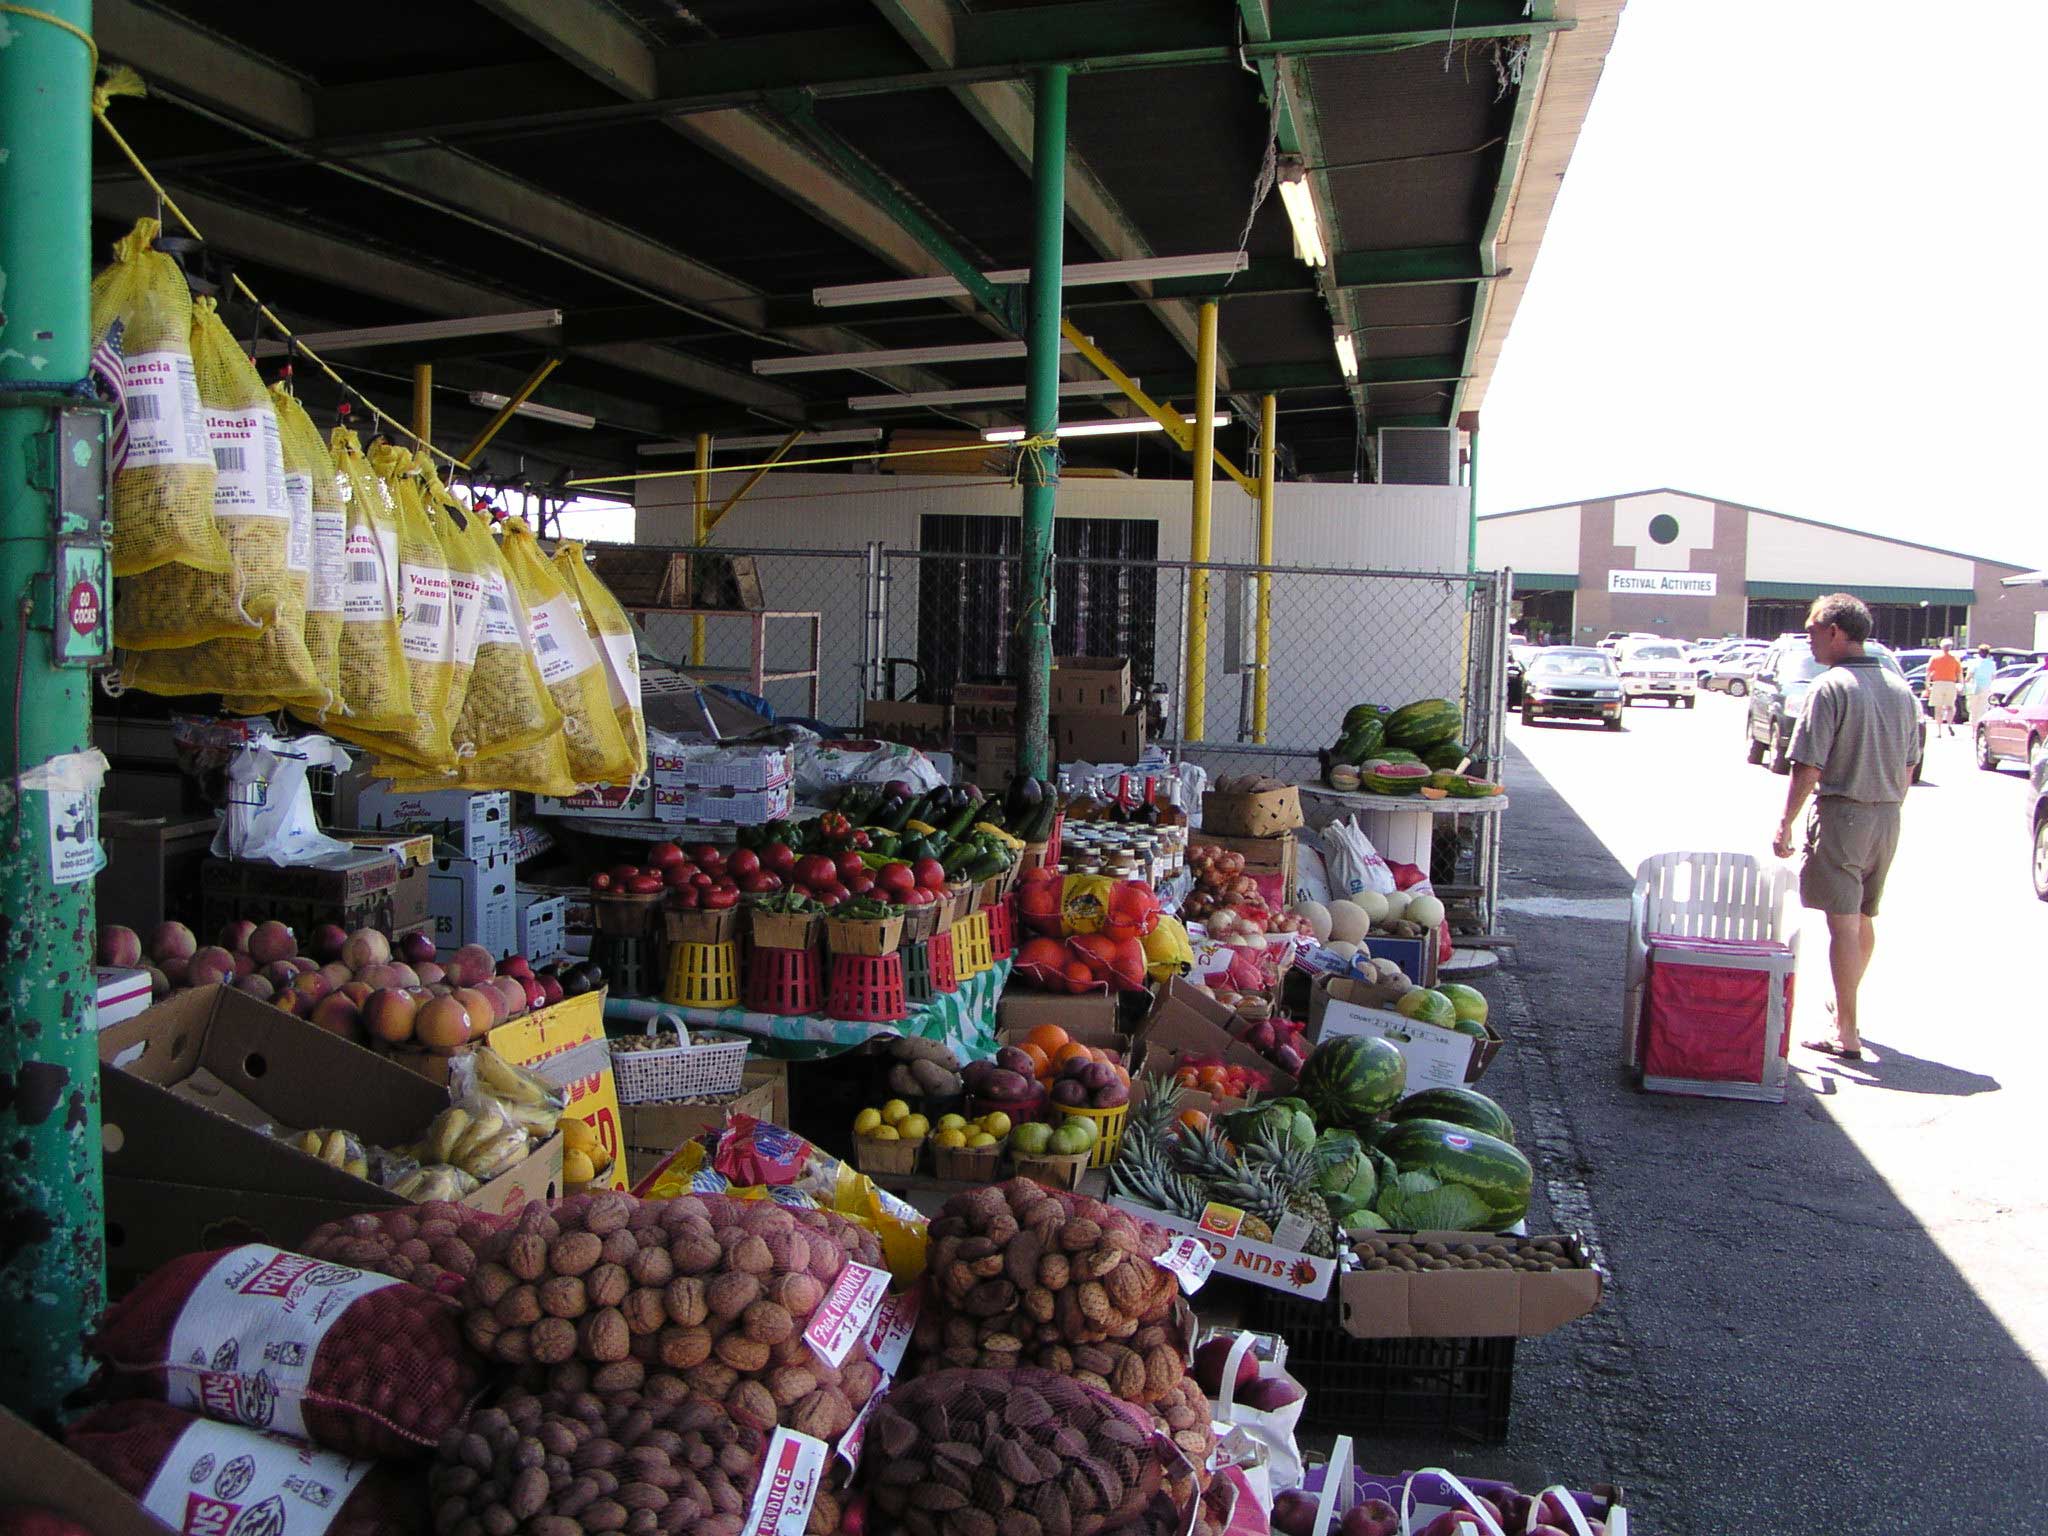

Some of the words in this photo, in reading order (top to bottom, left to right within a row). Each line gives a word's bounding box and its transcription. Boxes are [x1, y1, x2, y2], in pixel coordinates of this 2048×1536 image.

[209, 431, 251, 439] eanuts
[451, 579, 480, 592] encia
[1613, 575, 1656, 590] FESTIVAL
[1661, 577, 1712, 591] ACTIVITIES
[80, 592, 90, 607] GO
[74, 608, 96, 624] COCKS
[656, 756, 684, 769] Dole
[656, 789, 685, 803] Dole
[1233, 1248, 1286, 1278] SUN
[830, 1266, 867, 1314] PRODUCE
[759, 1467, 791, 1531] PRODUCE
